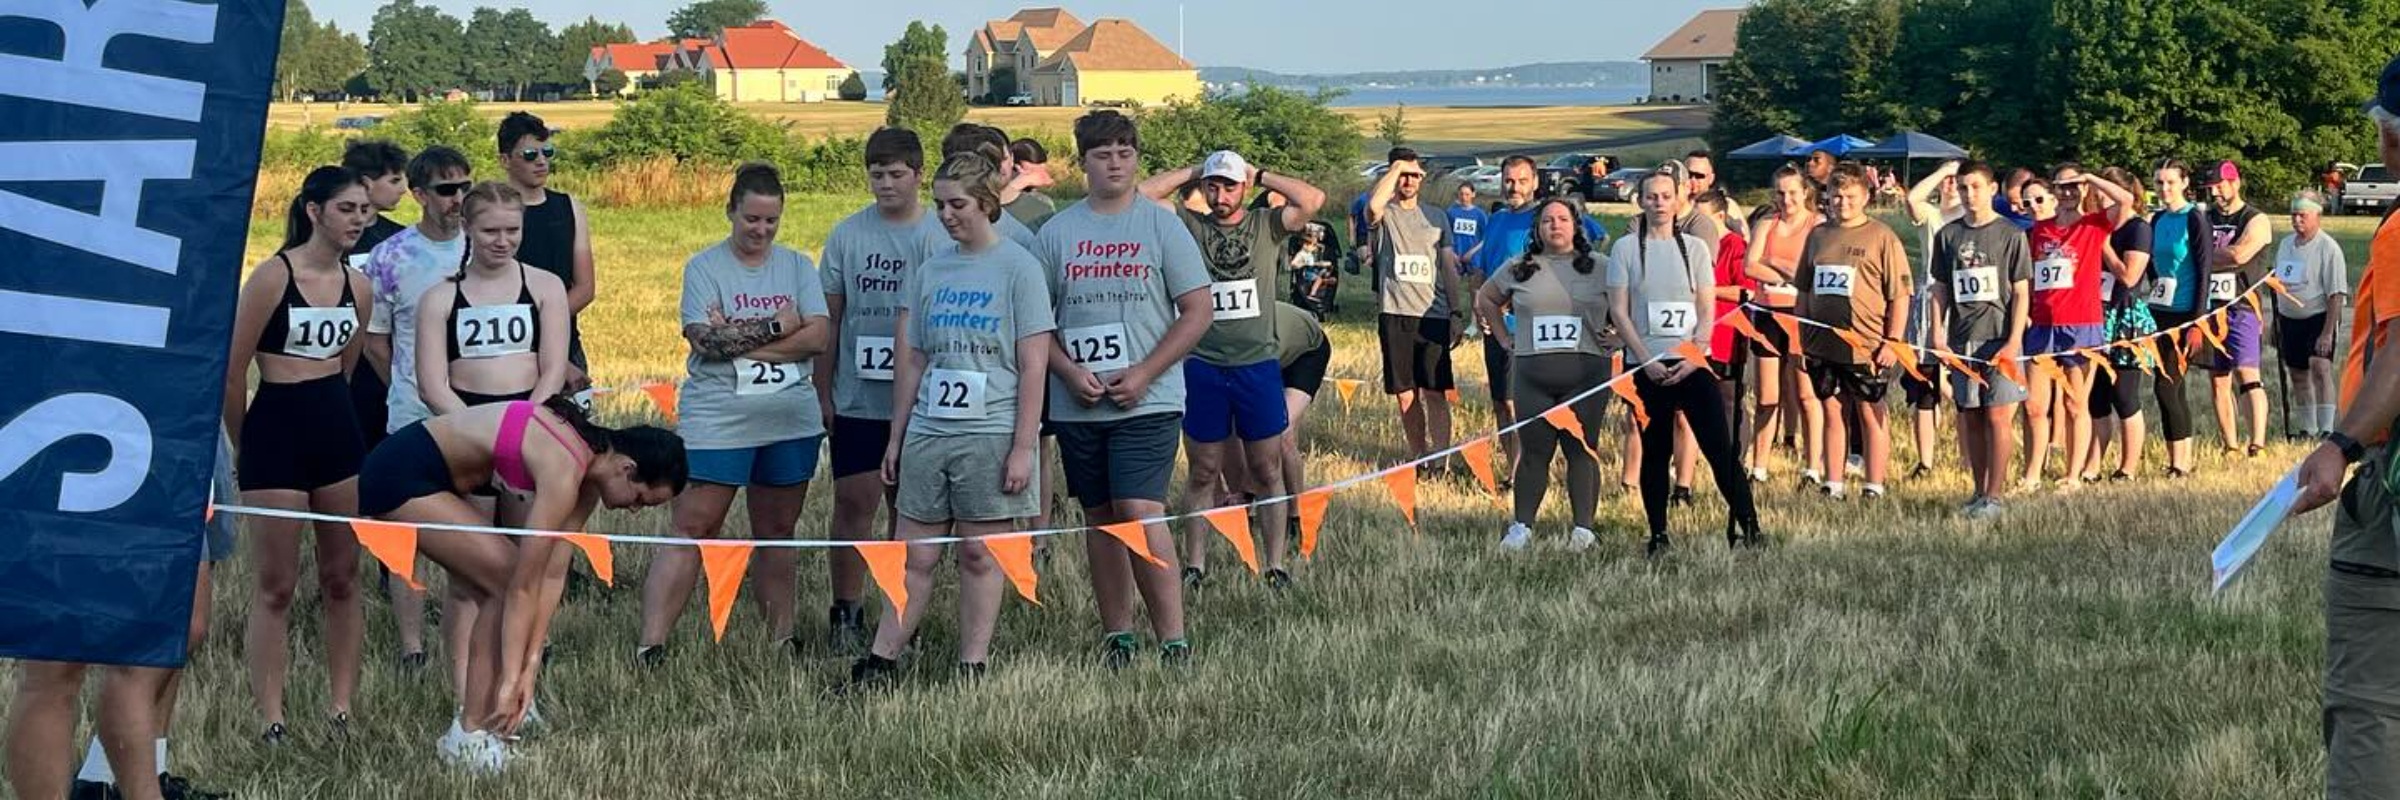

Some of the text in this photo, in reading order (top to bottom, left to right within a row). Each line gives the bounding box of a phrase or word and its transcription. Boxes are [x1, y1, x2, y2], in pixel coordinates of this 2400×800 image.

[1076, 240, 1141, 258] Sloppy
[864, 253, 907, 274] Slop
[1064, 261, 1151, 281] Sprinters
[1399, 261, 1429, 276] 106
[1817, 272, 1849, 289] 122
[2041, 266, 2062, 283] 97
[1958, 276, 1994, 294] 101
[2211, 280, 2231, 293] 20
[734, 293, 792, 312] Sloppy
[934, 286, 994, 308] Sloppy
[1213, 289, 1253, 311] 117
[1660, 310, 1686, 328] 27
[295, 319, 353, 348] 108
[464, 316, 527, 347] 210
[1538, 324, 1577, 342] 112
[1071, 334, 1121, 363] 125
[751, 361, 786, 385] 25
[938, 381, 969, 408] 22
